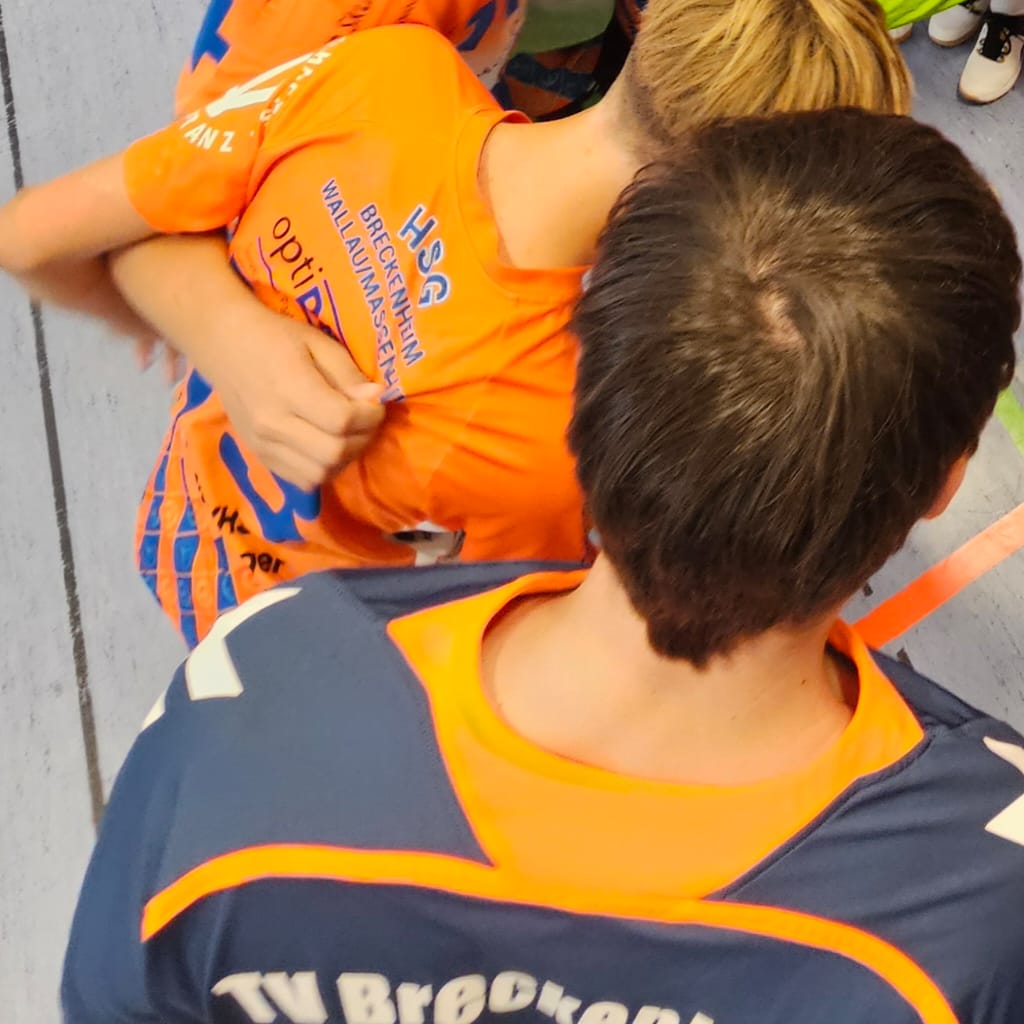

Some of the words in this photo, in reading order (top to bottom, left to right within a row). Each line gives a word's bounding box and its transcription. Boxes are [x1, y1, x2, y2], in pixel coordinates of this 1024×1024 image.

[359, 203, 425, 366] BRECKENHEIM
[398, 205, 450, 309] HSG
[211, 971, 328, 1024] TV
